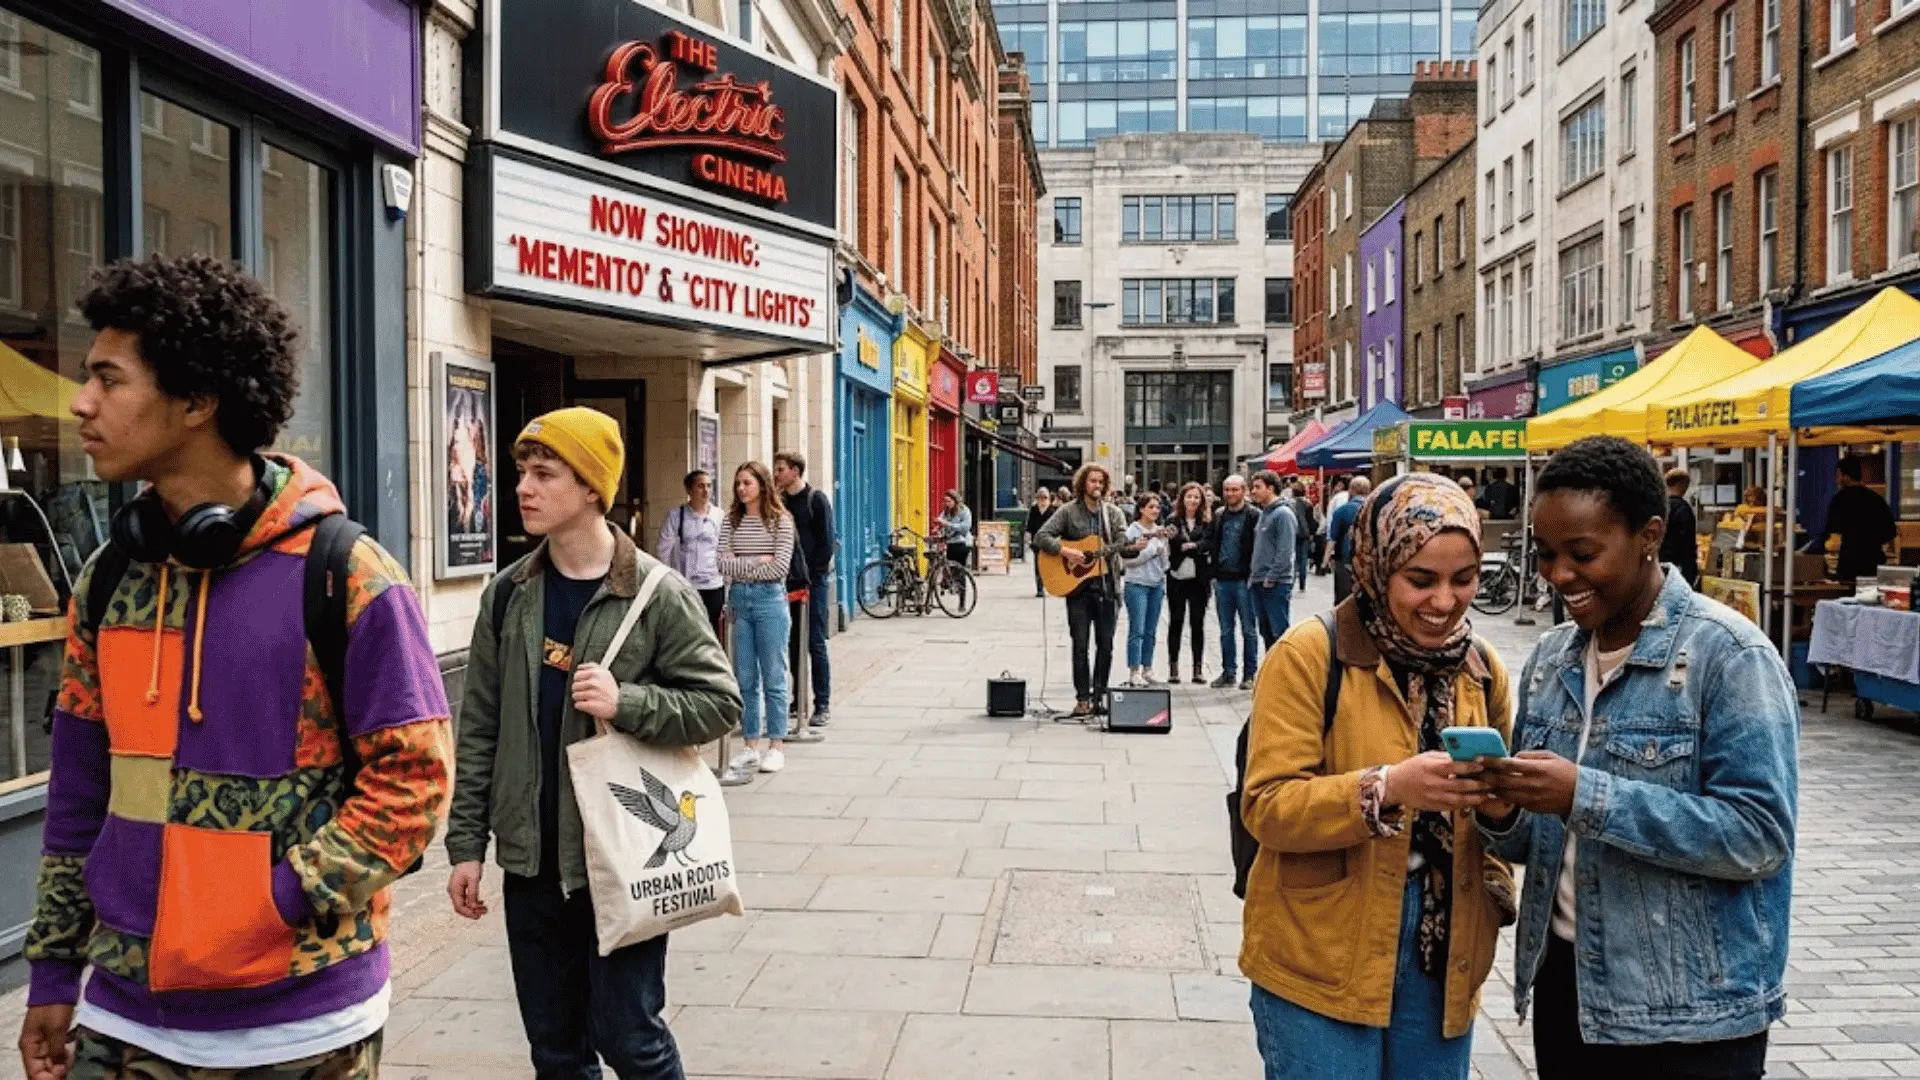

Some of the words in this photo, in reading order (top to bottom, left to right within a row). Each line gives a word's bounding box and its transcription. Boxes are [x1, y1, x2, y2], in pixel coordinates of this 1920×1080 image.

[670, 30, 719, 72] THE
[589, 40, 786, 142] Electric
[694, 154, 789, 204] CINEMA
[589, 194, 646, 241] NOW
[656, 212, 761, 268] SHOWING:
[658, 268, 674, 303] &
[1417, 430, 1529, 450] FALAFEL
[630, 872, 683, 901] URBAN
[686, 860, 731, 887] ROOTS
[653, 885, 717, 917] FESTIVAL
